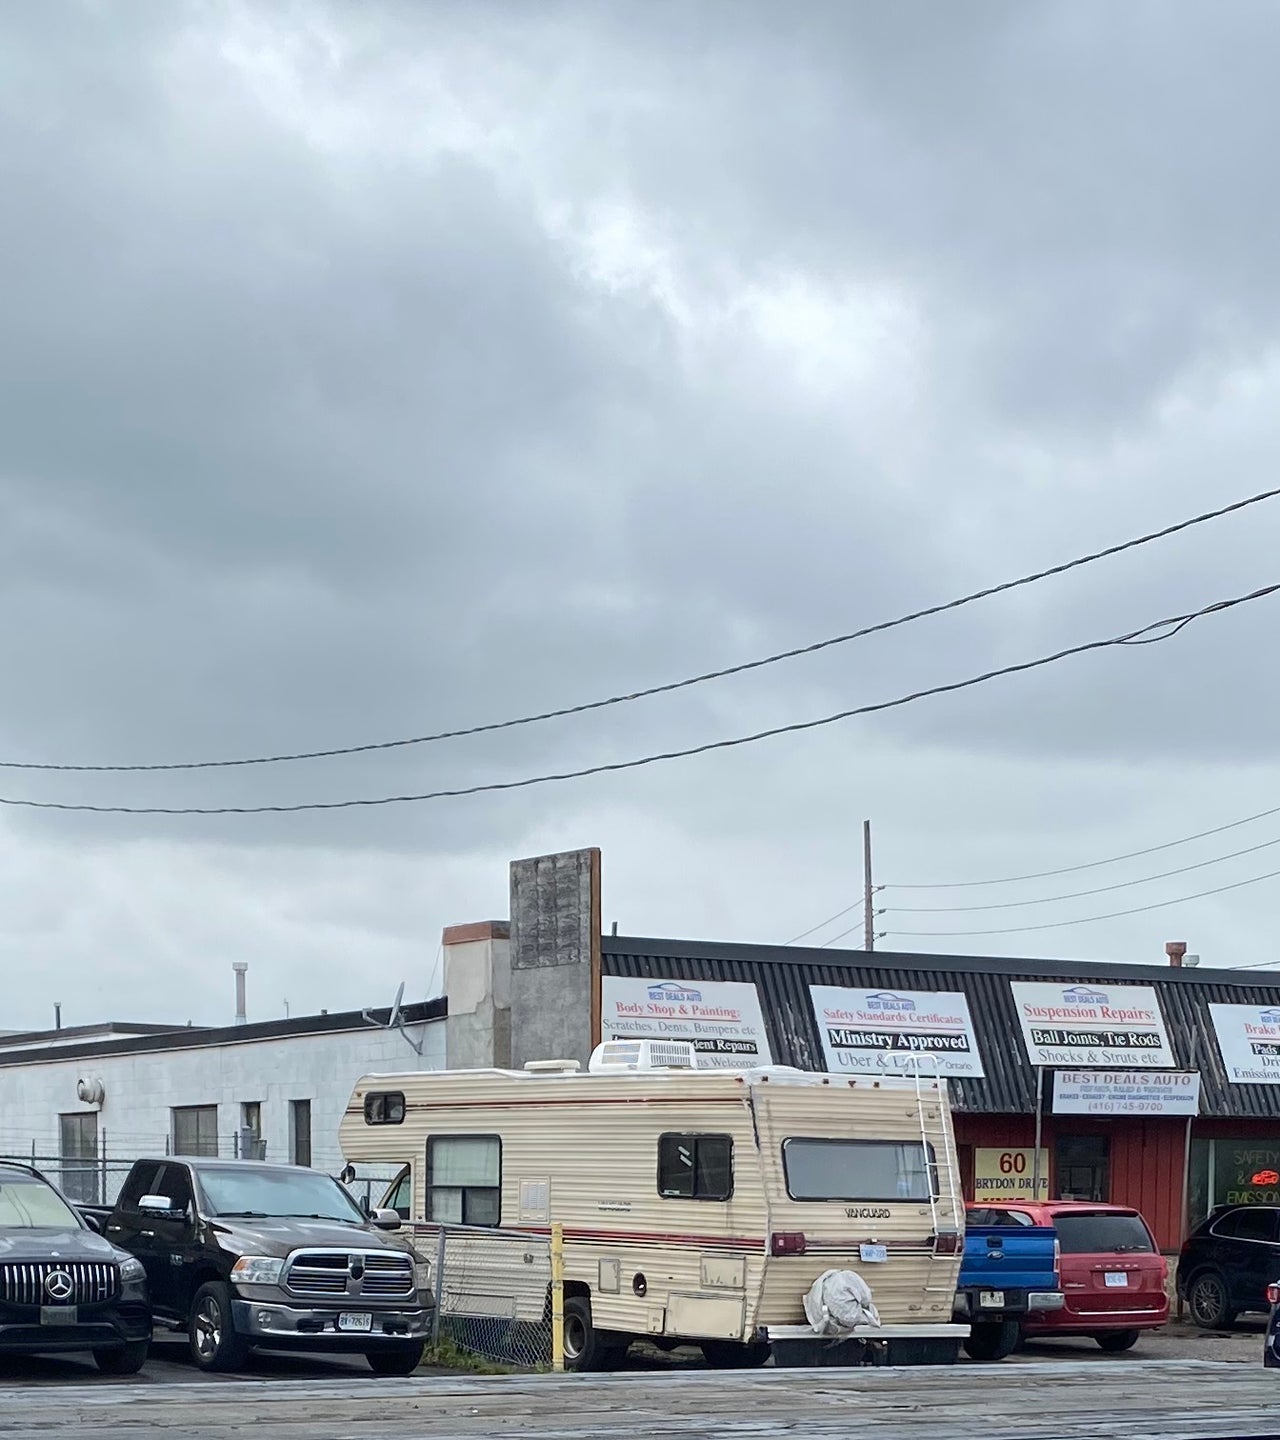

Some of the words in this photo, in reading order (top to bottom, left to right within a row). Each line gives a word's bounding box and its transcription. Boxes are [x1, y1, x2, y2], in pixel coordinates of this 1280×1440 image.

[616, 1002, 644, 1015] Body
[647, 1003, 676, 1016] Shop
[679, 1004, 688, 1014] &
[824, 1008, 854, 1022] Safety
[857, 1010, 906, 1021] Standards
[909, 1013, 963, 1024] Certificates
[1023, 1003, 1096, 1020] Suspension
[1100, 1006, 1156, 1022] Repairs:
[694, 1023, 740, 1036] Bumpers
[1244, 1024, 1276, 1034] Brake
[830, 1030, 893, 1049] Ministry
[897, 1033, 967, 1050] Approved
[1034, 1030, 1058, 1044] Ball
[1107, 1032, 1126, 1046] Tie
[1128, 1033, 1160, 1046] Rods
[716, 1040, 756, 1054] Repairs
[1254, 1044, 1278, 1055] Pads
[712, 1057, 757, 1069] Welcome
[838, 1052, 871, 1066] Uber
[1039, 1049, 1084, 1062] Shocks
[1088, 1050, 1100, 1063] &
[1102, 1051, 1138, 1064] Struts
[1062, 1074, 1100, 1084] BEST
[1104, 1074, 1149, 1085] DEALS
[1153, 1076, 1191, 1086] AUTO
[1234, 1068, 1280, 1080] Emission
[1000, 1152, 1026, 1174] 60
[1234, 1150, 1280, 1165] SAFETY
[976, 1178, 1015, 1189] BRYDON
[1018, 1178, 1048, 1188] DRIE
[845, 1208, 890, 1218] VANGUARD
